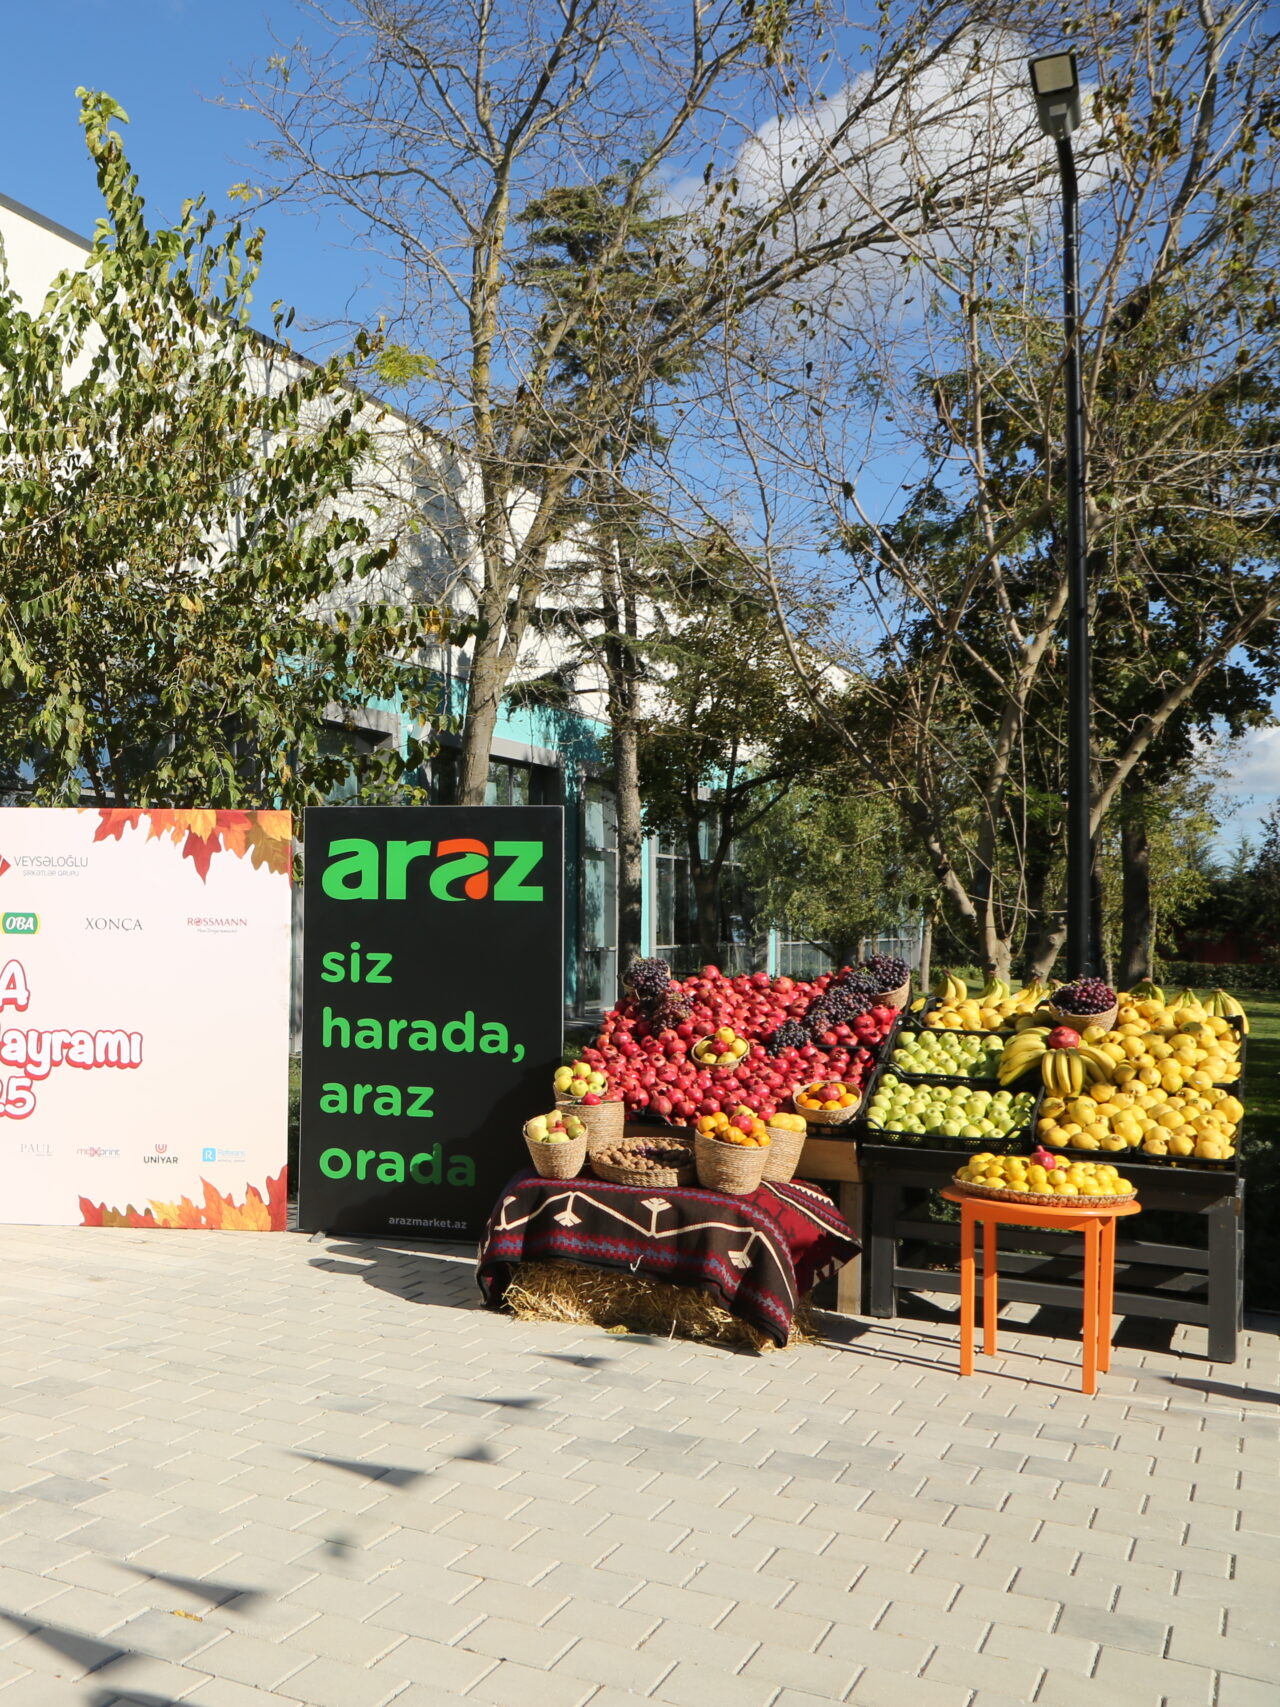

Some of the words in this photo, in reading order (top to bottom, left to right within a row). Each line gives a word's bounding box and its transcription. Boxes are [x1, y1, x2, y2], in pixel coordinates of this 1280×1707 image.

[14, 854, 89, 868] VEYSƏLOĞLU
[321, 838, 544, 902] araz
[6, 916, 34, 930] OBA
[85, 917, 143, 932] XONÇA
[187, 917, 247, 927] ROSSMANN
[321, 941, 393, 984] siz
[322, 1006, 526, 1063] harada,
[319, 1082, 434, 1118] araz
[21, 1144, 52, 1153] PAUL
[319, 1142, 477, 1187] orada
[388, 1216, 468, 1229] arazmarket.az
